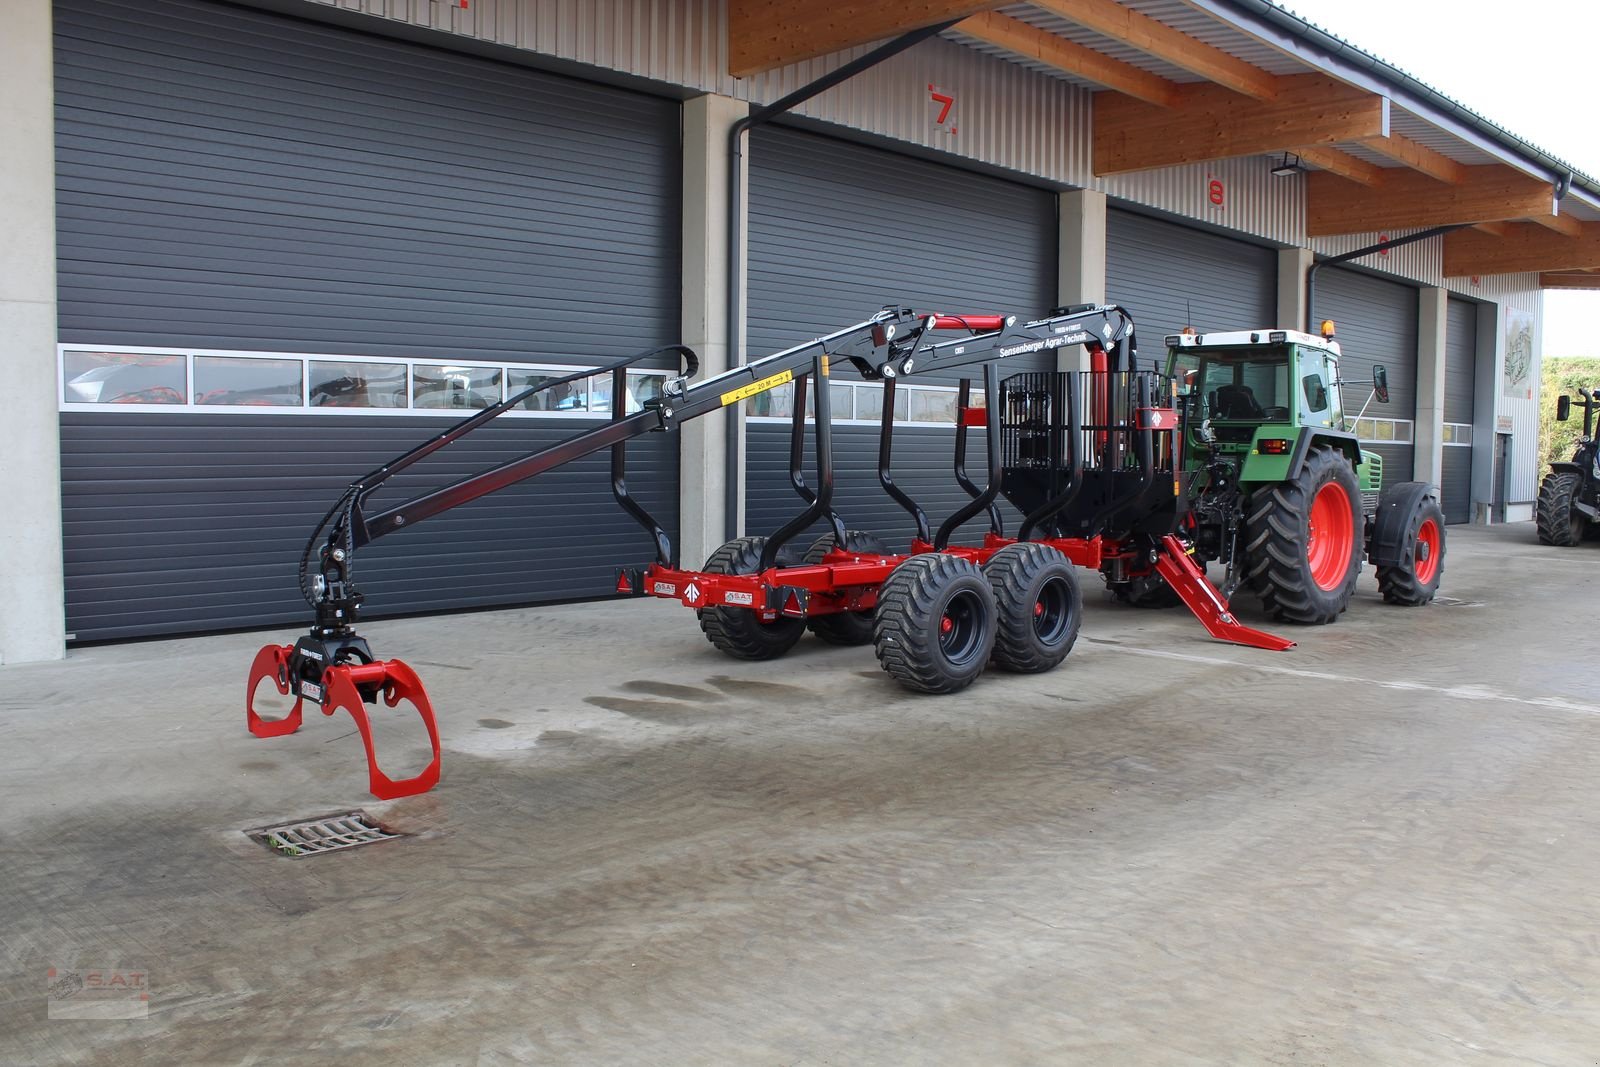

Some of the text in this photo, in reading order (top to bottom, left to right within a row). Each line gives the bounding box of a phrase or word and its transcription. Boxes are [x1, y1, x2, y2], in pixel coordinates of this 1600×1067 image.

[931, 92, 954, 124] 7
[999, 331, 1087, 358] Sensenberger Agrar-Technik
